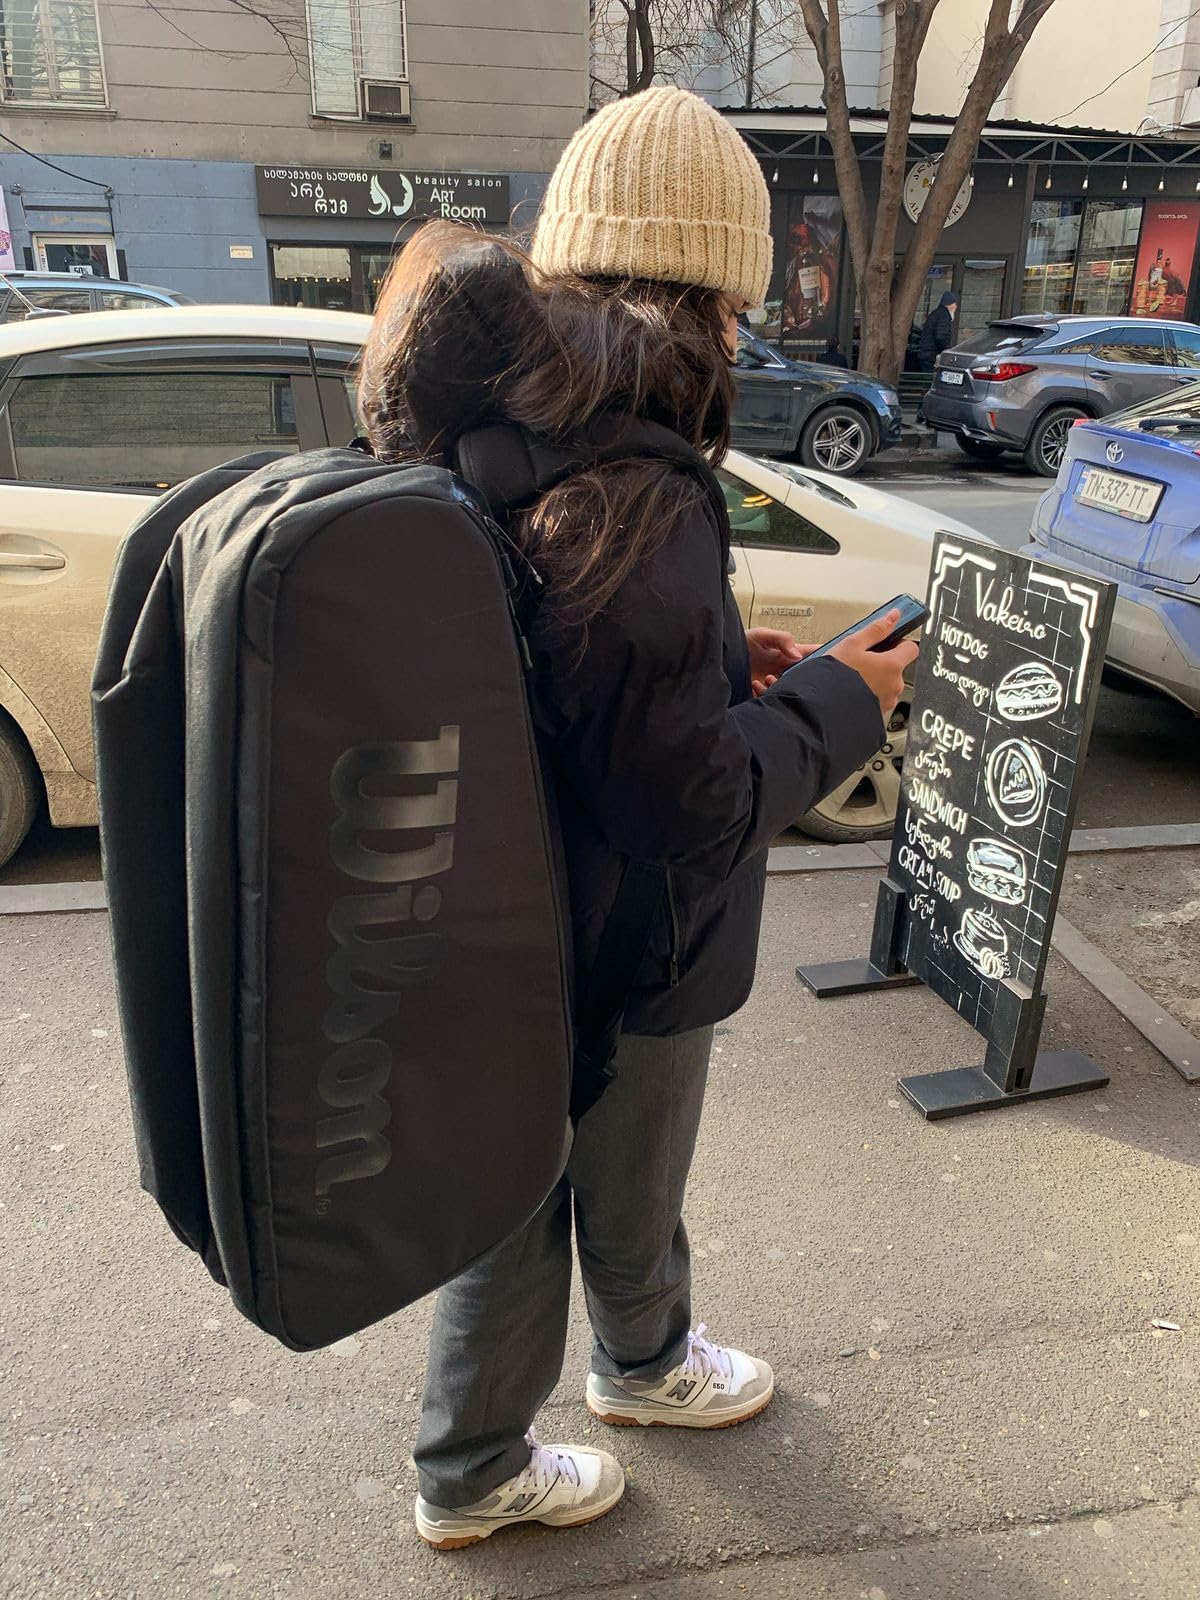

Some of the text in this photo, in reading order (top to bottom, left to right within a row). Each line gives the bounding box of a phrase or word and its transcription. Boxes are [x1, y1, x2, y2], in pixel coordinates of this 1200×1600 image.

[263, 169, 369, 183] სილამაზის სალონი
[415, 175, 502, 188] beauty salon
[290, 182, 325, 198] არტ
[314, 198, 348, 215] რუმ
[441, 203, 487, 219] Room
[1086, 473, 1149, 510] TN-337-TT
[921, 708, 976, 761] CREPE
[908, 777, 969, 836] SANDWICH
[314, 724, 461, 1197] Wilson
